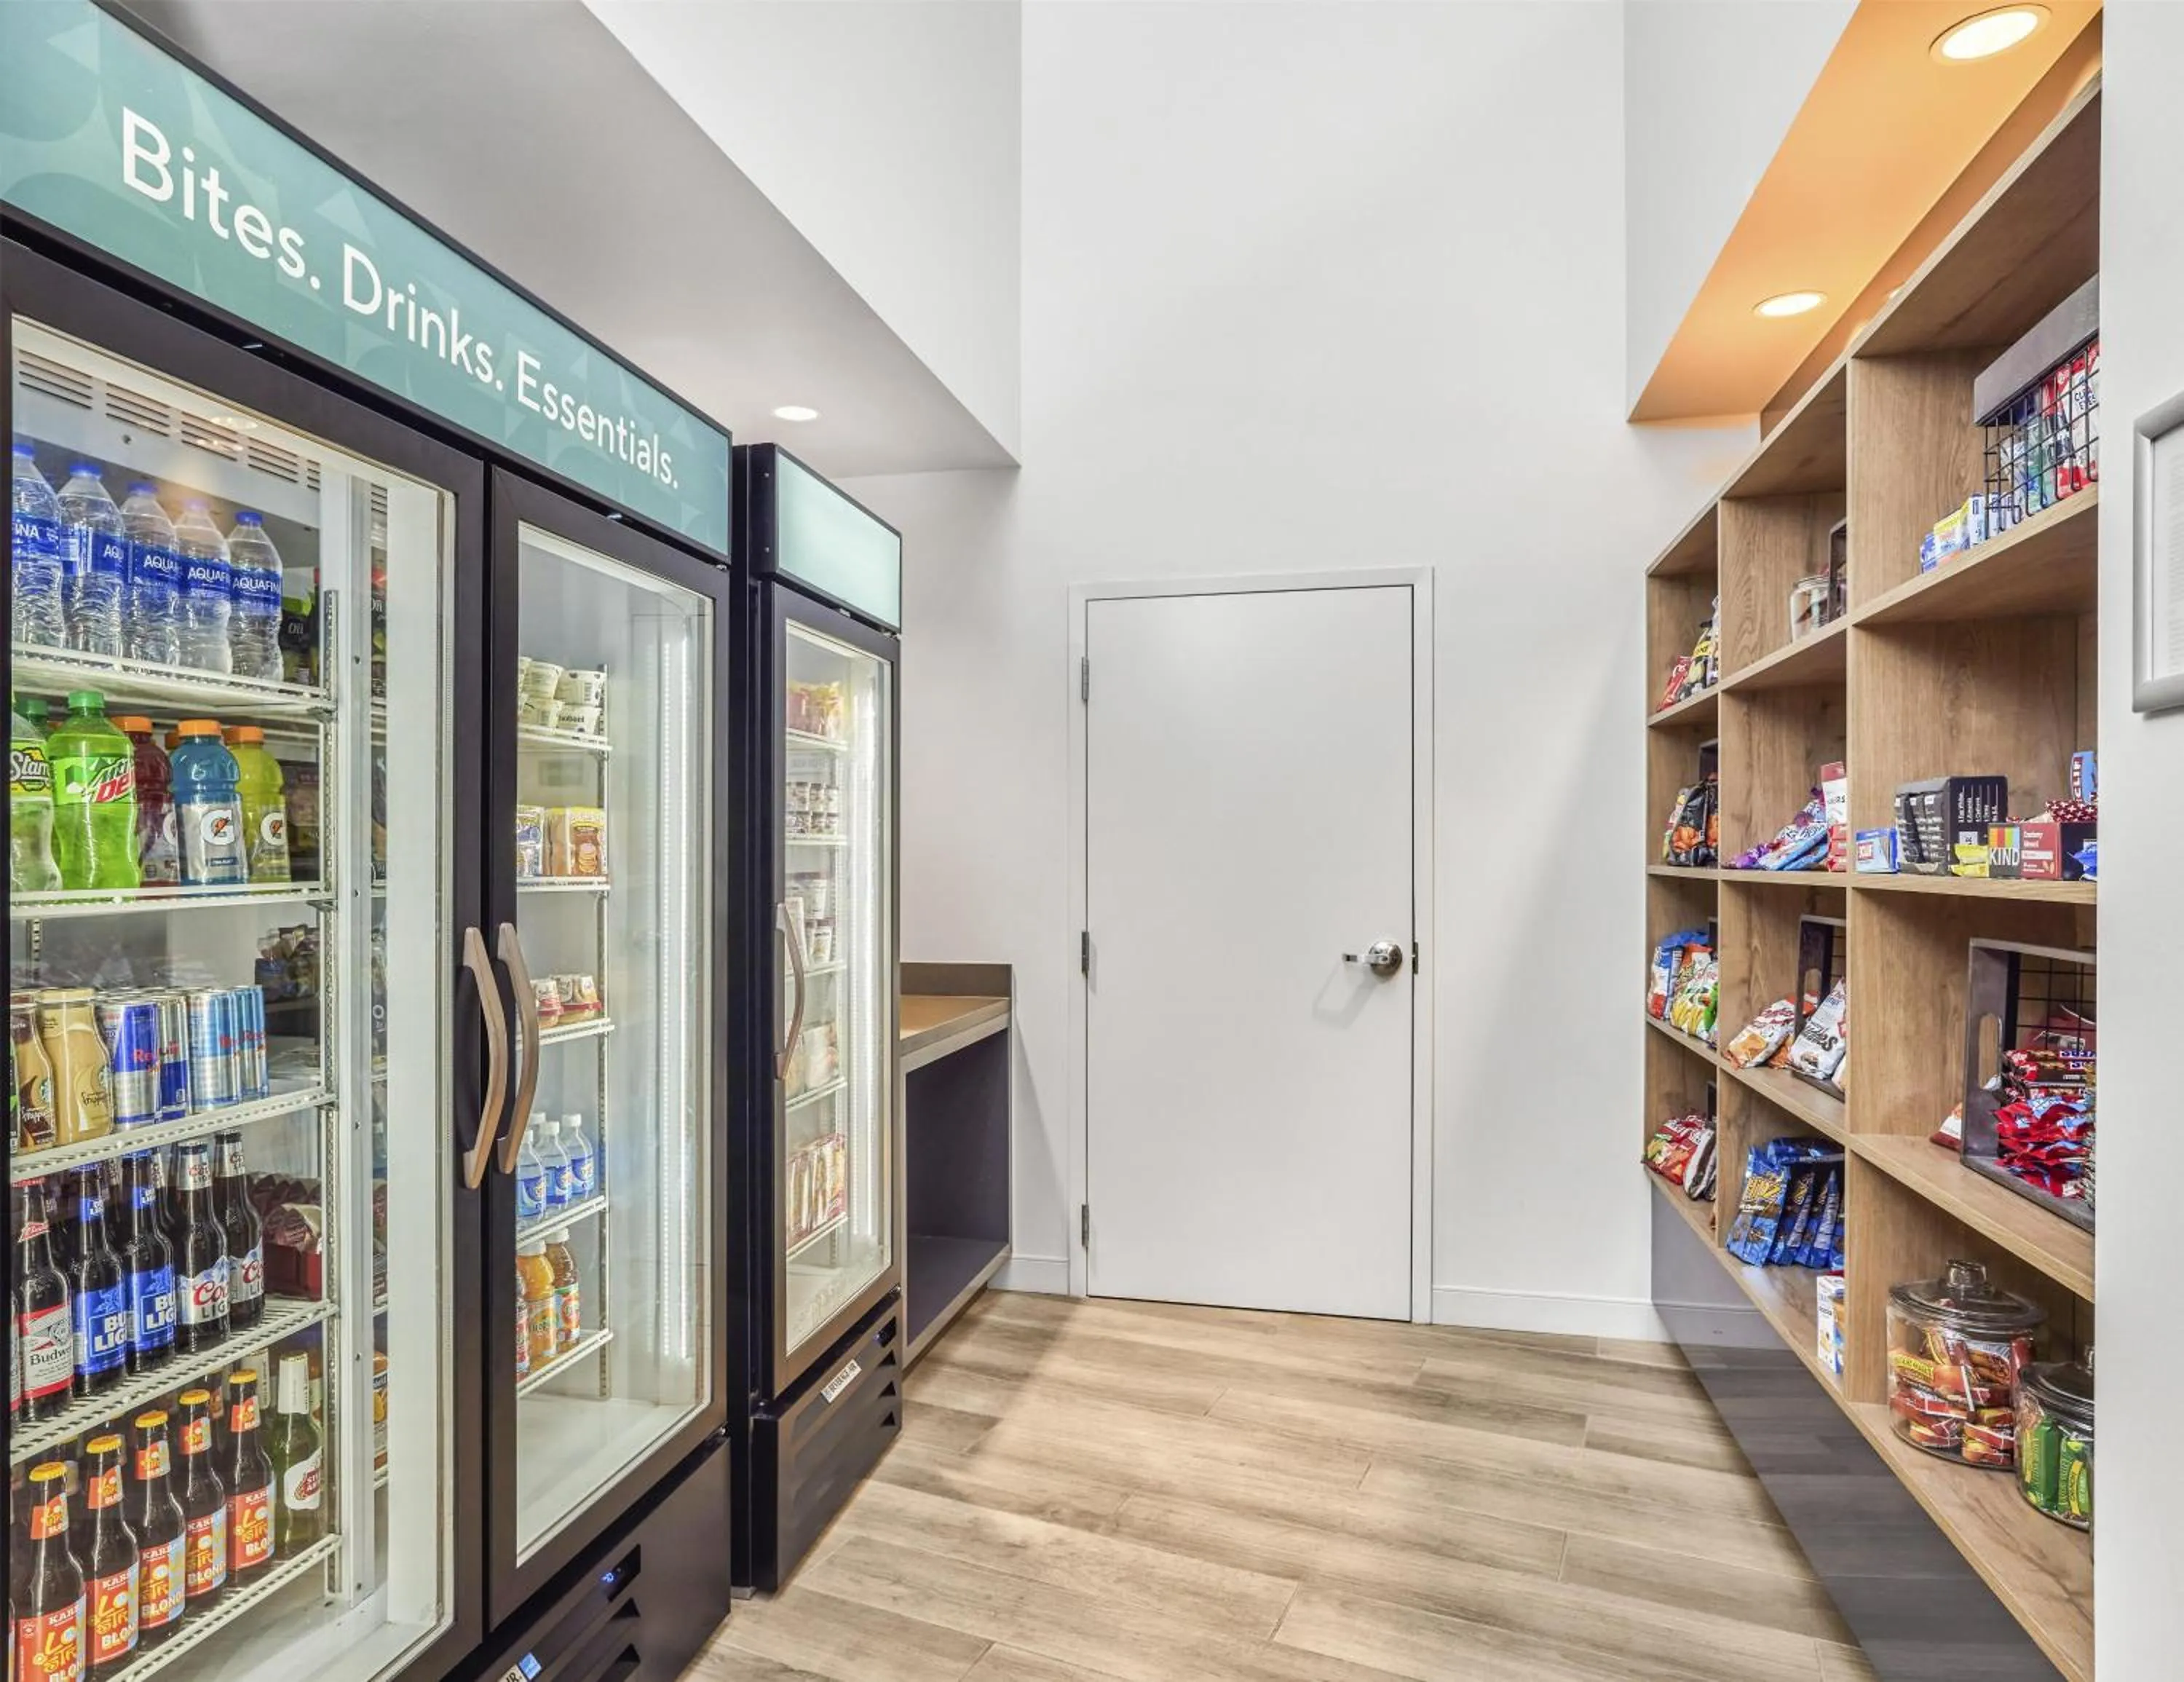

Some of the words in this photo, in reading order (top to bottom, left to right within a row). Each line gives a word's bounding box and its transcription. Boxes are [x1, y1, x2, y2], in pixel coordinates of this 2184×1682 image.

[124, 107, 320, 290] Bites.
[344, 244, 504, 391] Drinks.
[518, 351, 679, 489] Essentials.
[1989, 847, 2020, 866] KIND
[147, 1306, 175, 1330] LIG
[94, 1327, 126, 1352] LIG
